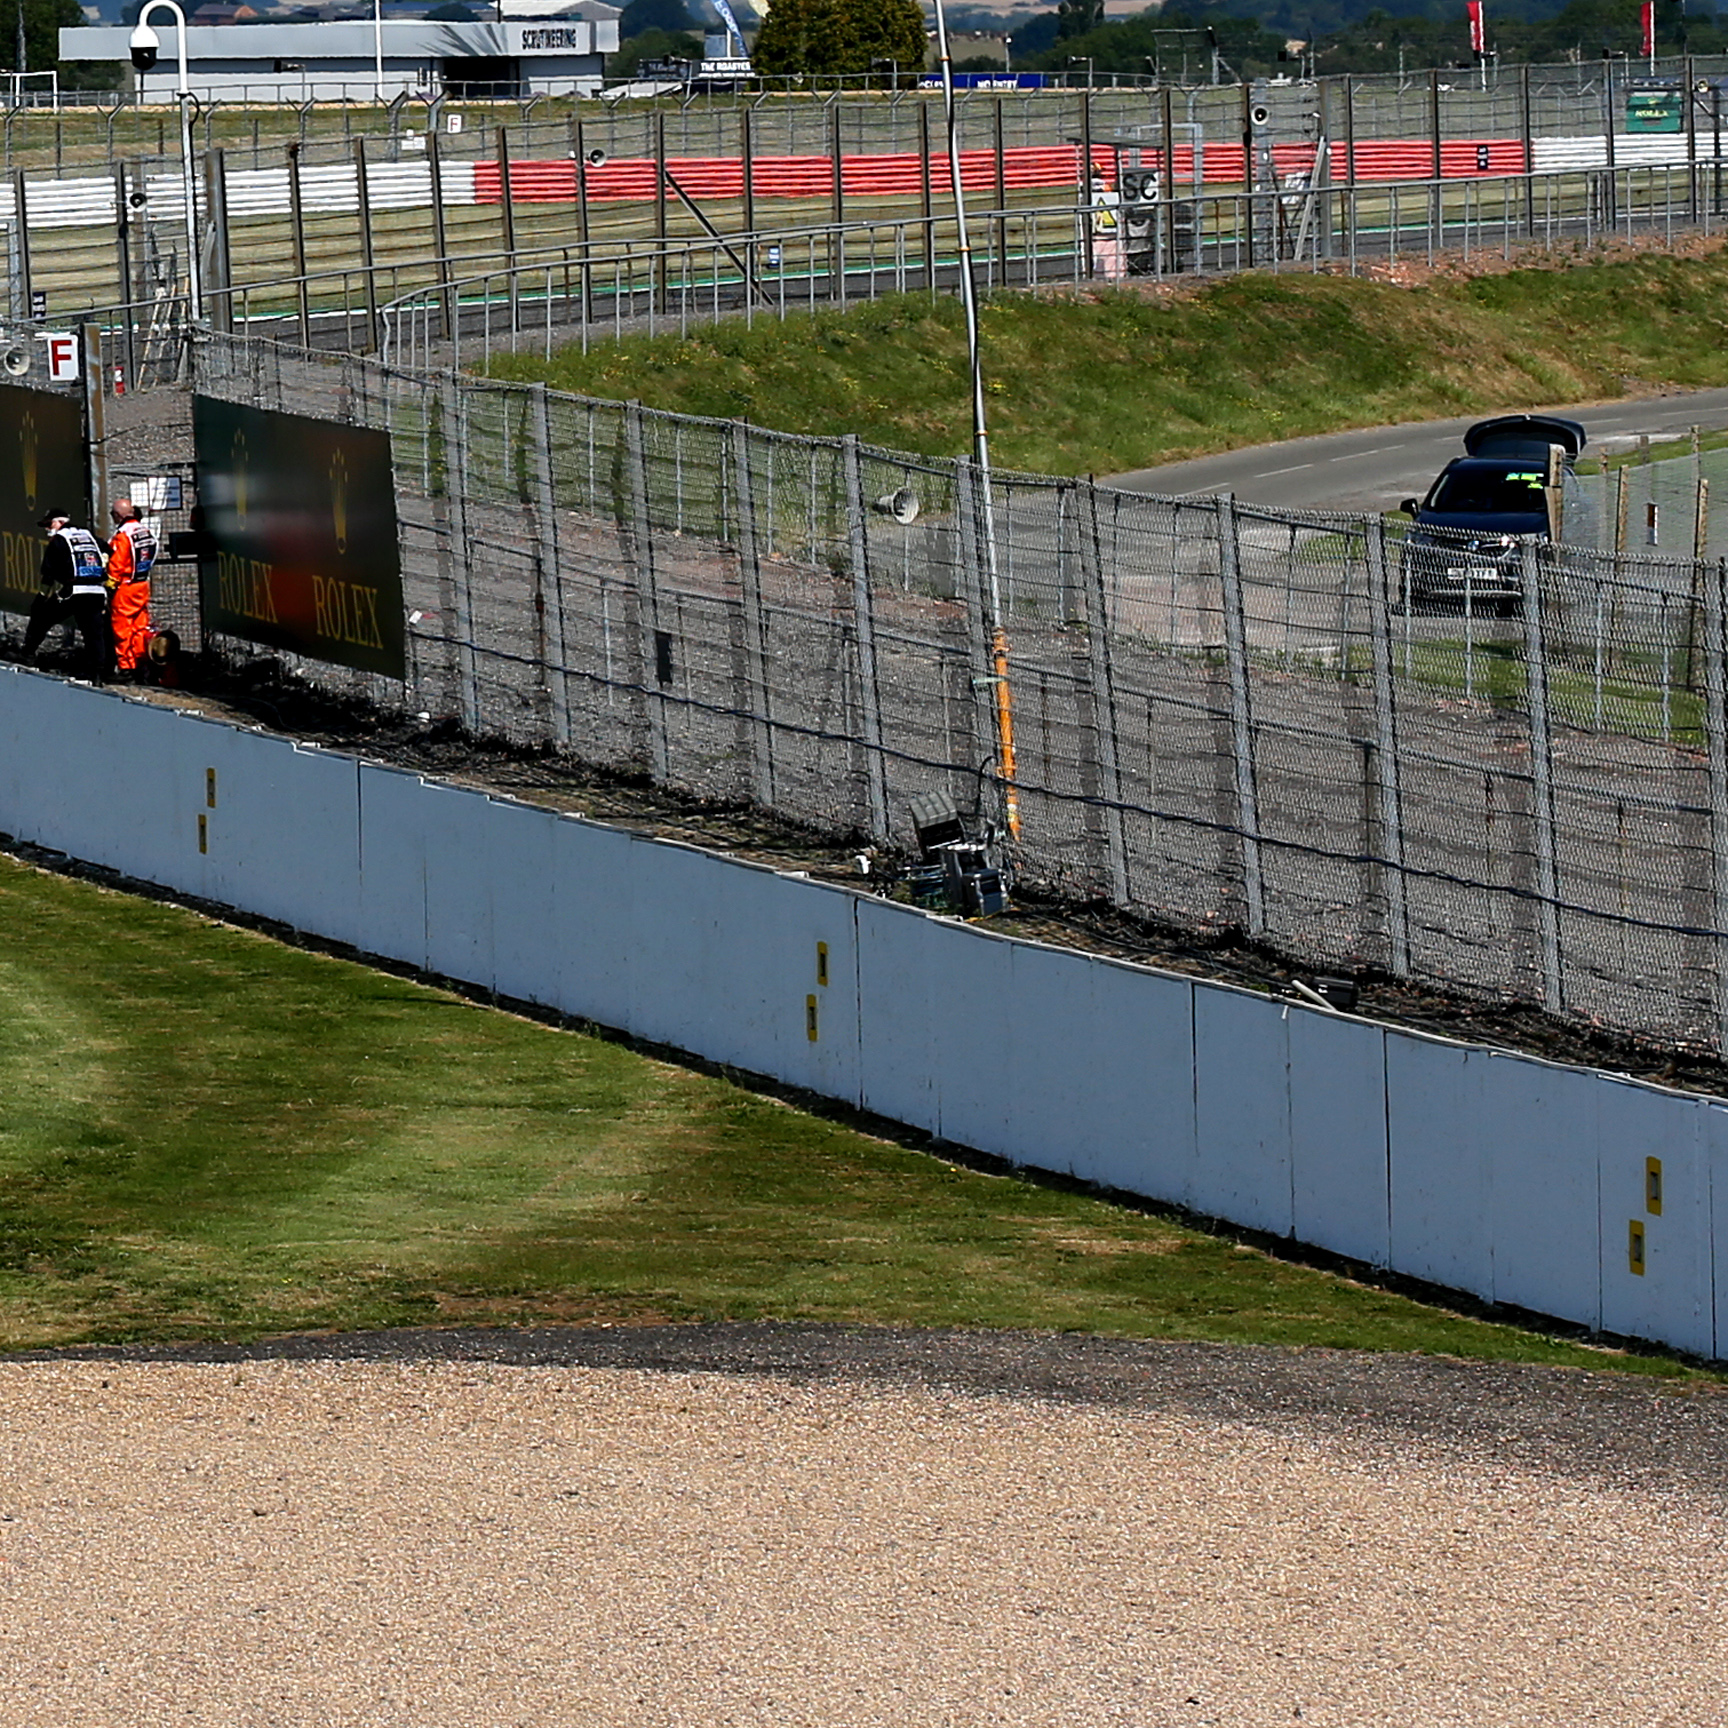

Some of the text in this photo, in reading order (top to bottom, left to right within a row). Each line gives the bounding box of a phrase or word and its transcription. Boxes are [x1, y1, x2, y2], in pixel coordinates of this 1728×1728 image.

[450, 117, 459, 131] F
[1123, 173, 1157, 201] SC
[50, 339, 73, 376] F
[2, 531, 48, 594] ROL
[217, 551, 279, 623] ROLEX
[312, 575, 384, 649] ROLEX
